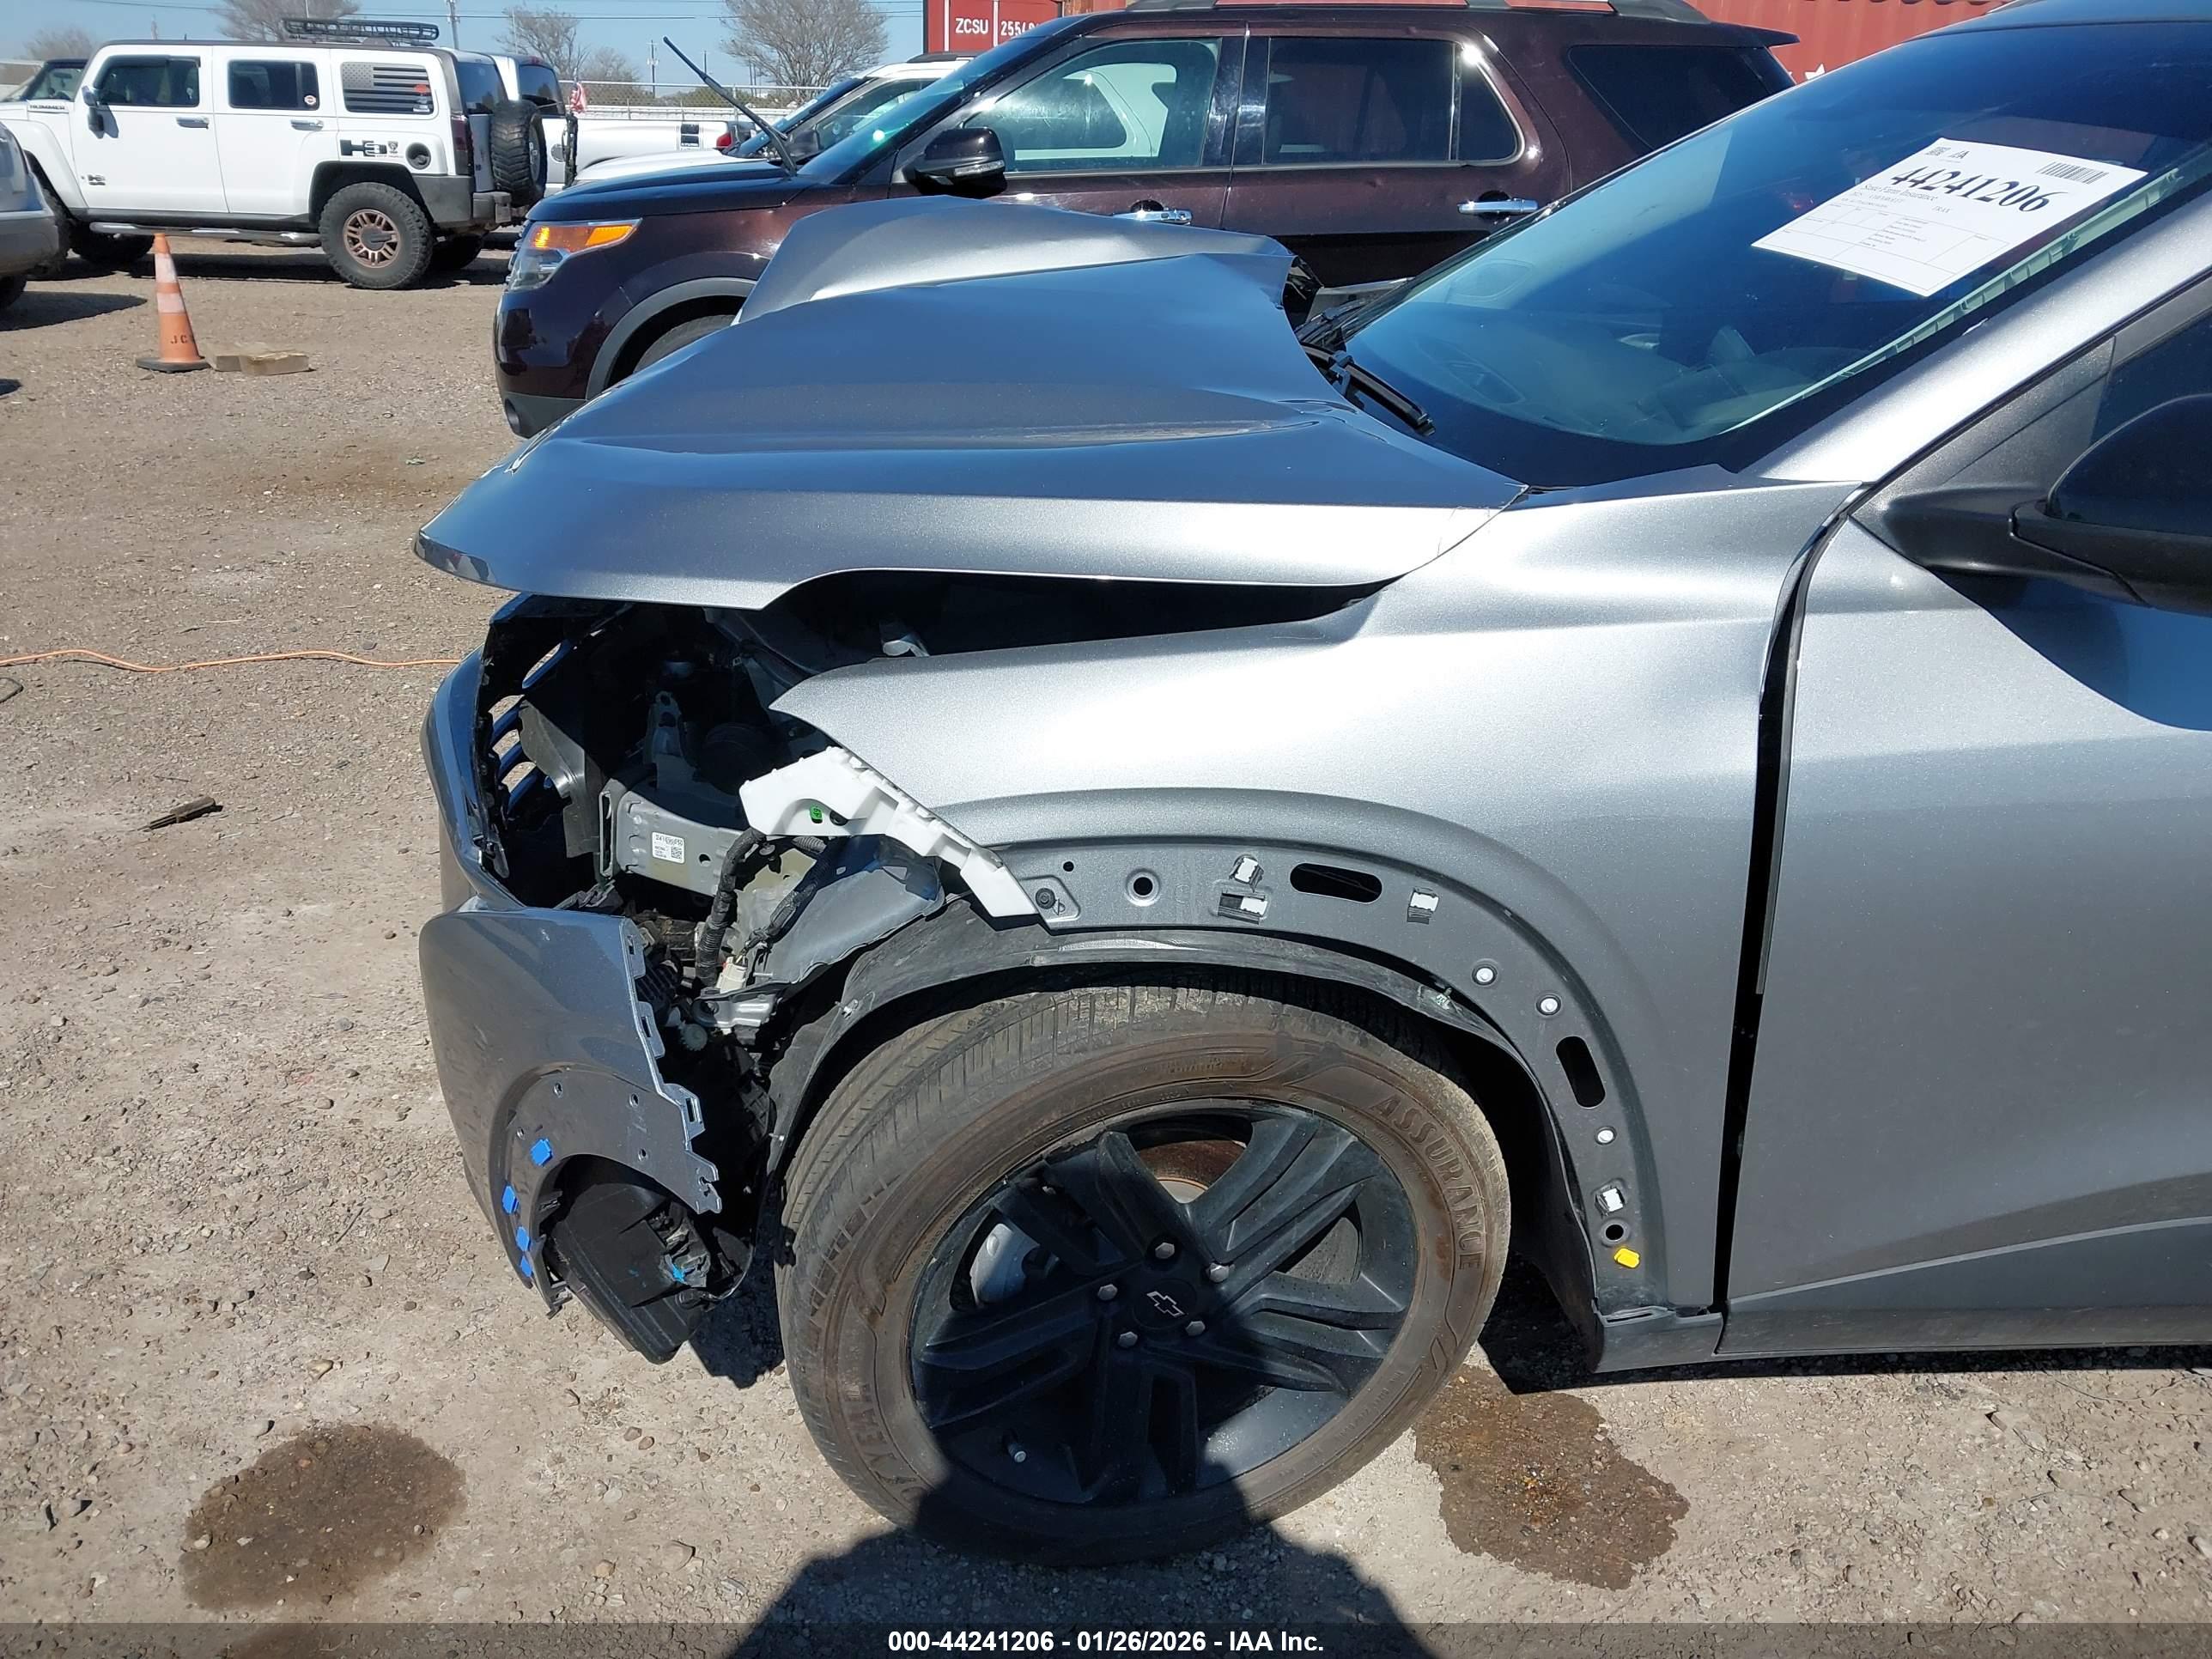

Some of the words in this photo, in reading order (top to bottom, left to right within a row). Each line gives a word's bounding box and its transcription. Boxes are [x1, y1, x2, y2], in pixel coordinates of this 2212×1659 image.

[955, 18, 988, 34] ZCSU
[1890, 166, 2068, 212] 44241206
[1367, 1095, 1481, 1270] ASSURANCE
